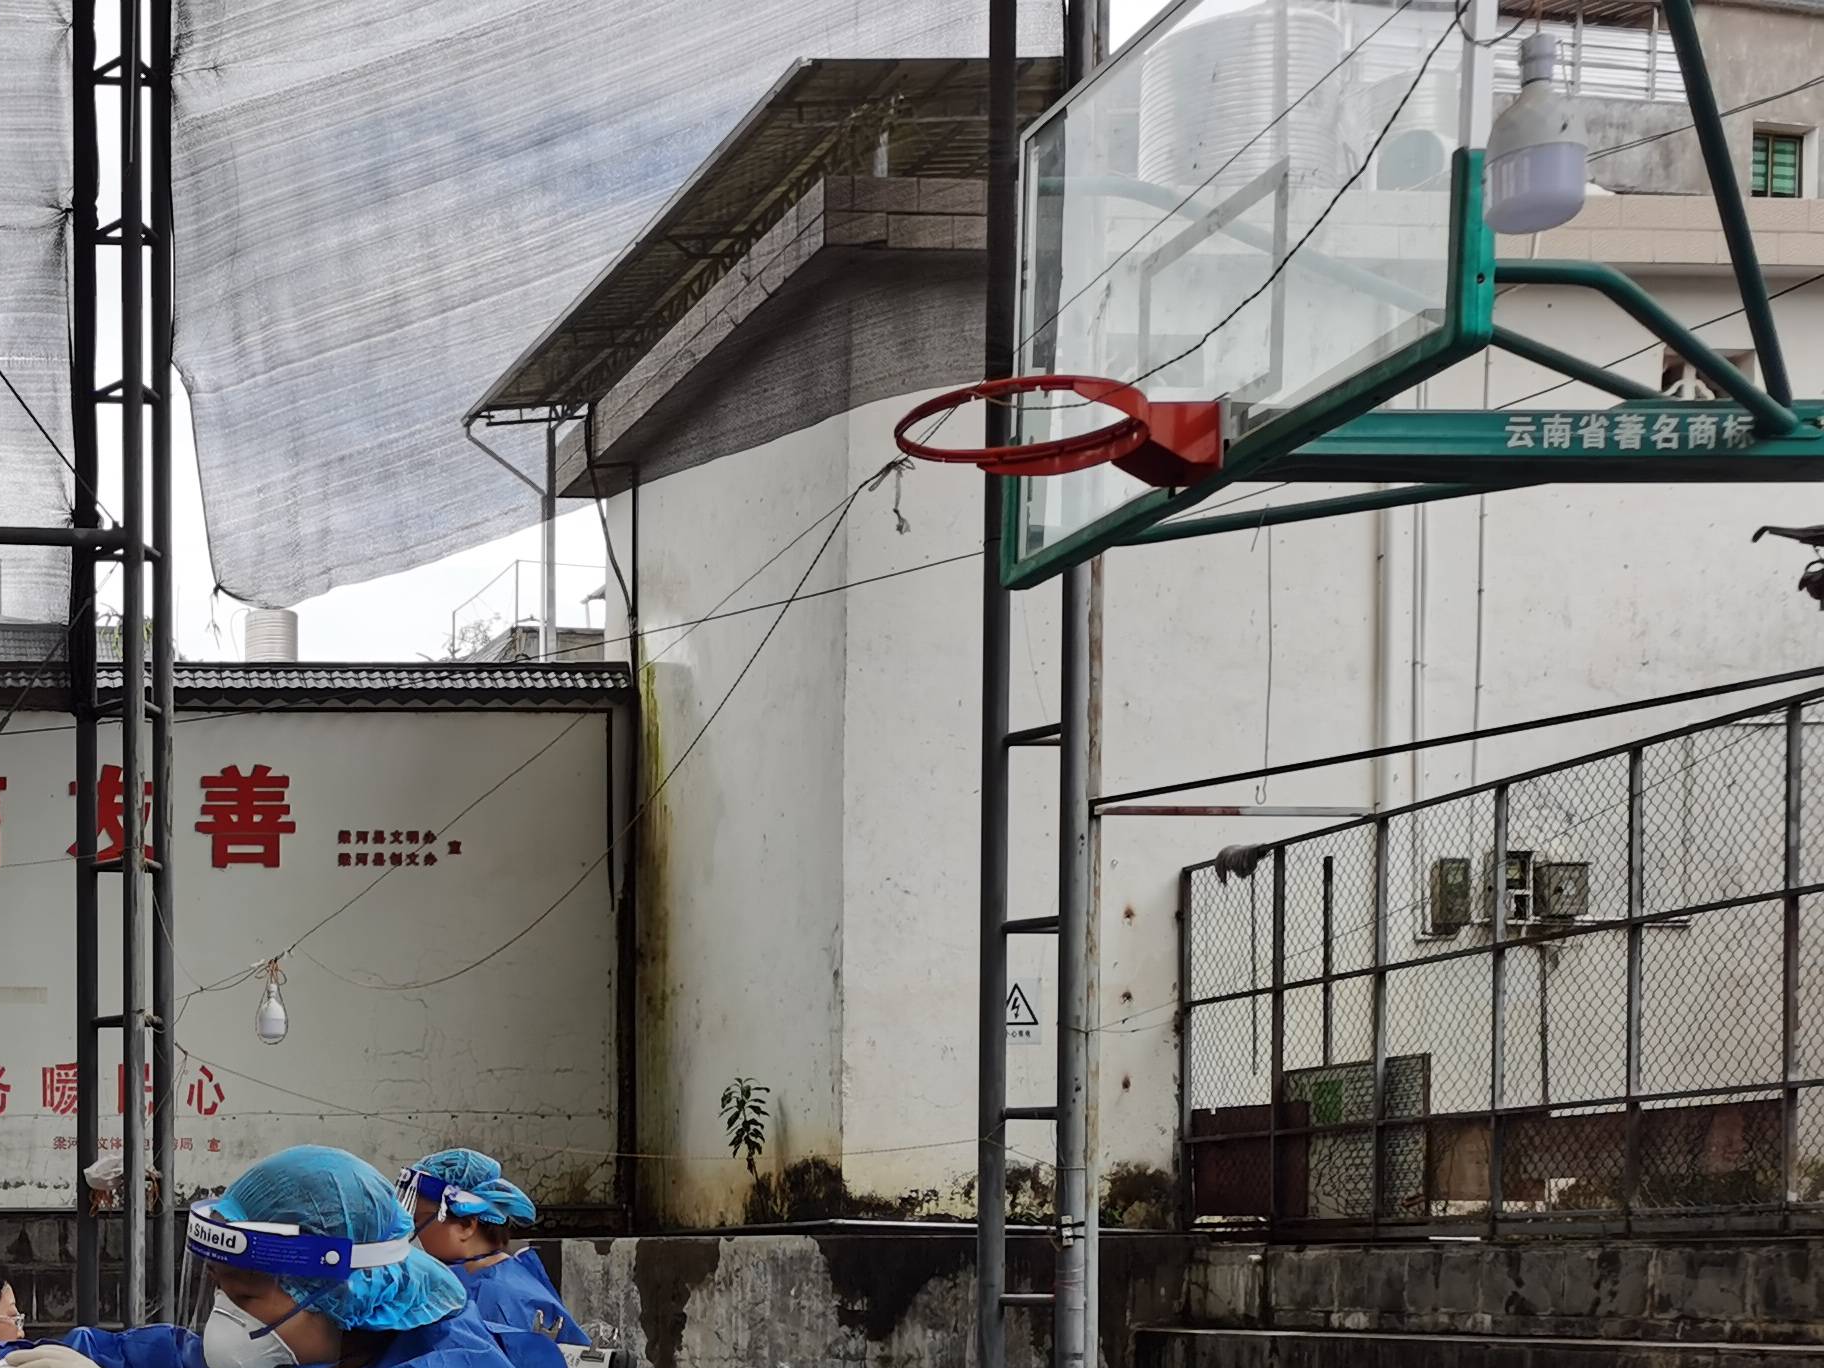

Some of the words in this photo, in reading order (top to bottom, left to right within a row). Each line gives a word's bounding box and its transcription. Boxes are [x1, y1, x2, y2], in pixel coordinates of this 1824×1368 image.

[1504, 413, 1756, 450] 云南省著名商标
[193, 1222, 237, 1249] Shield
